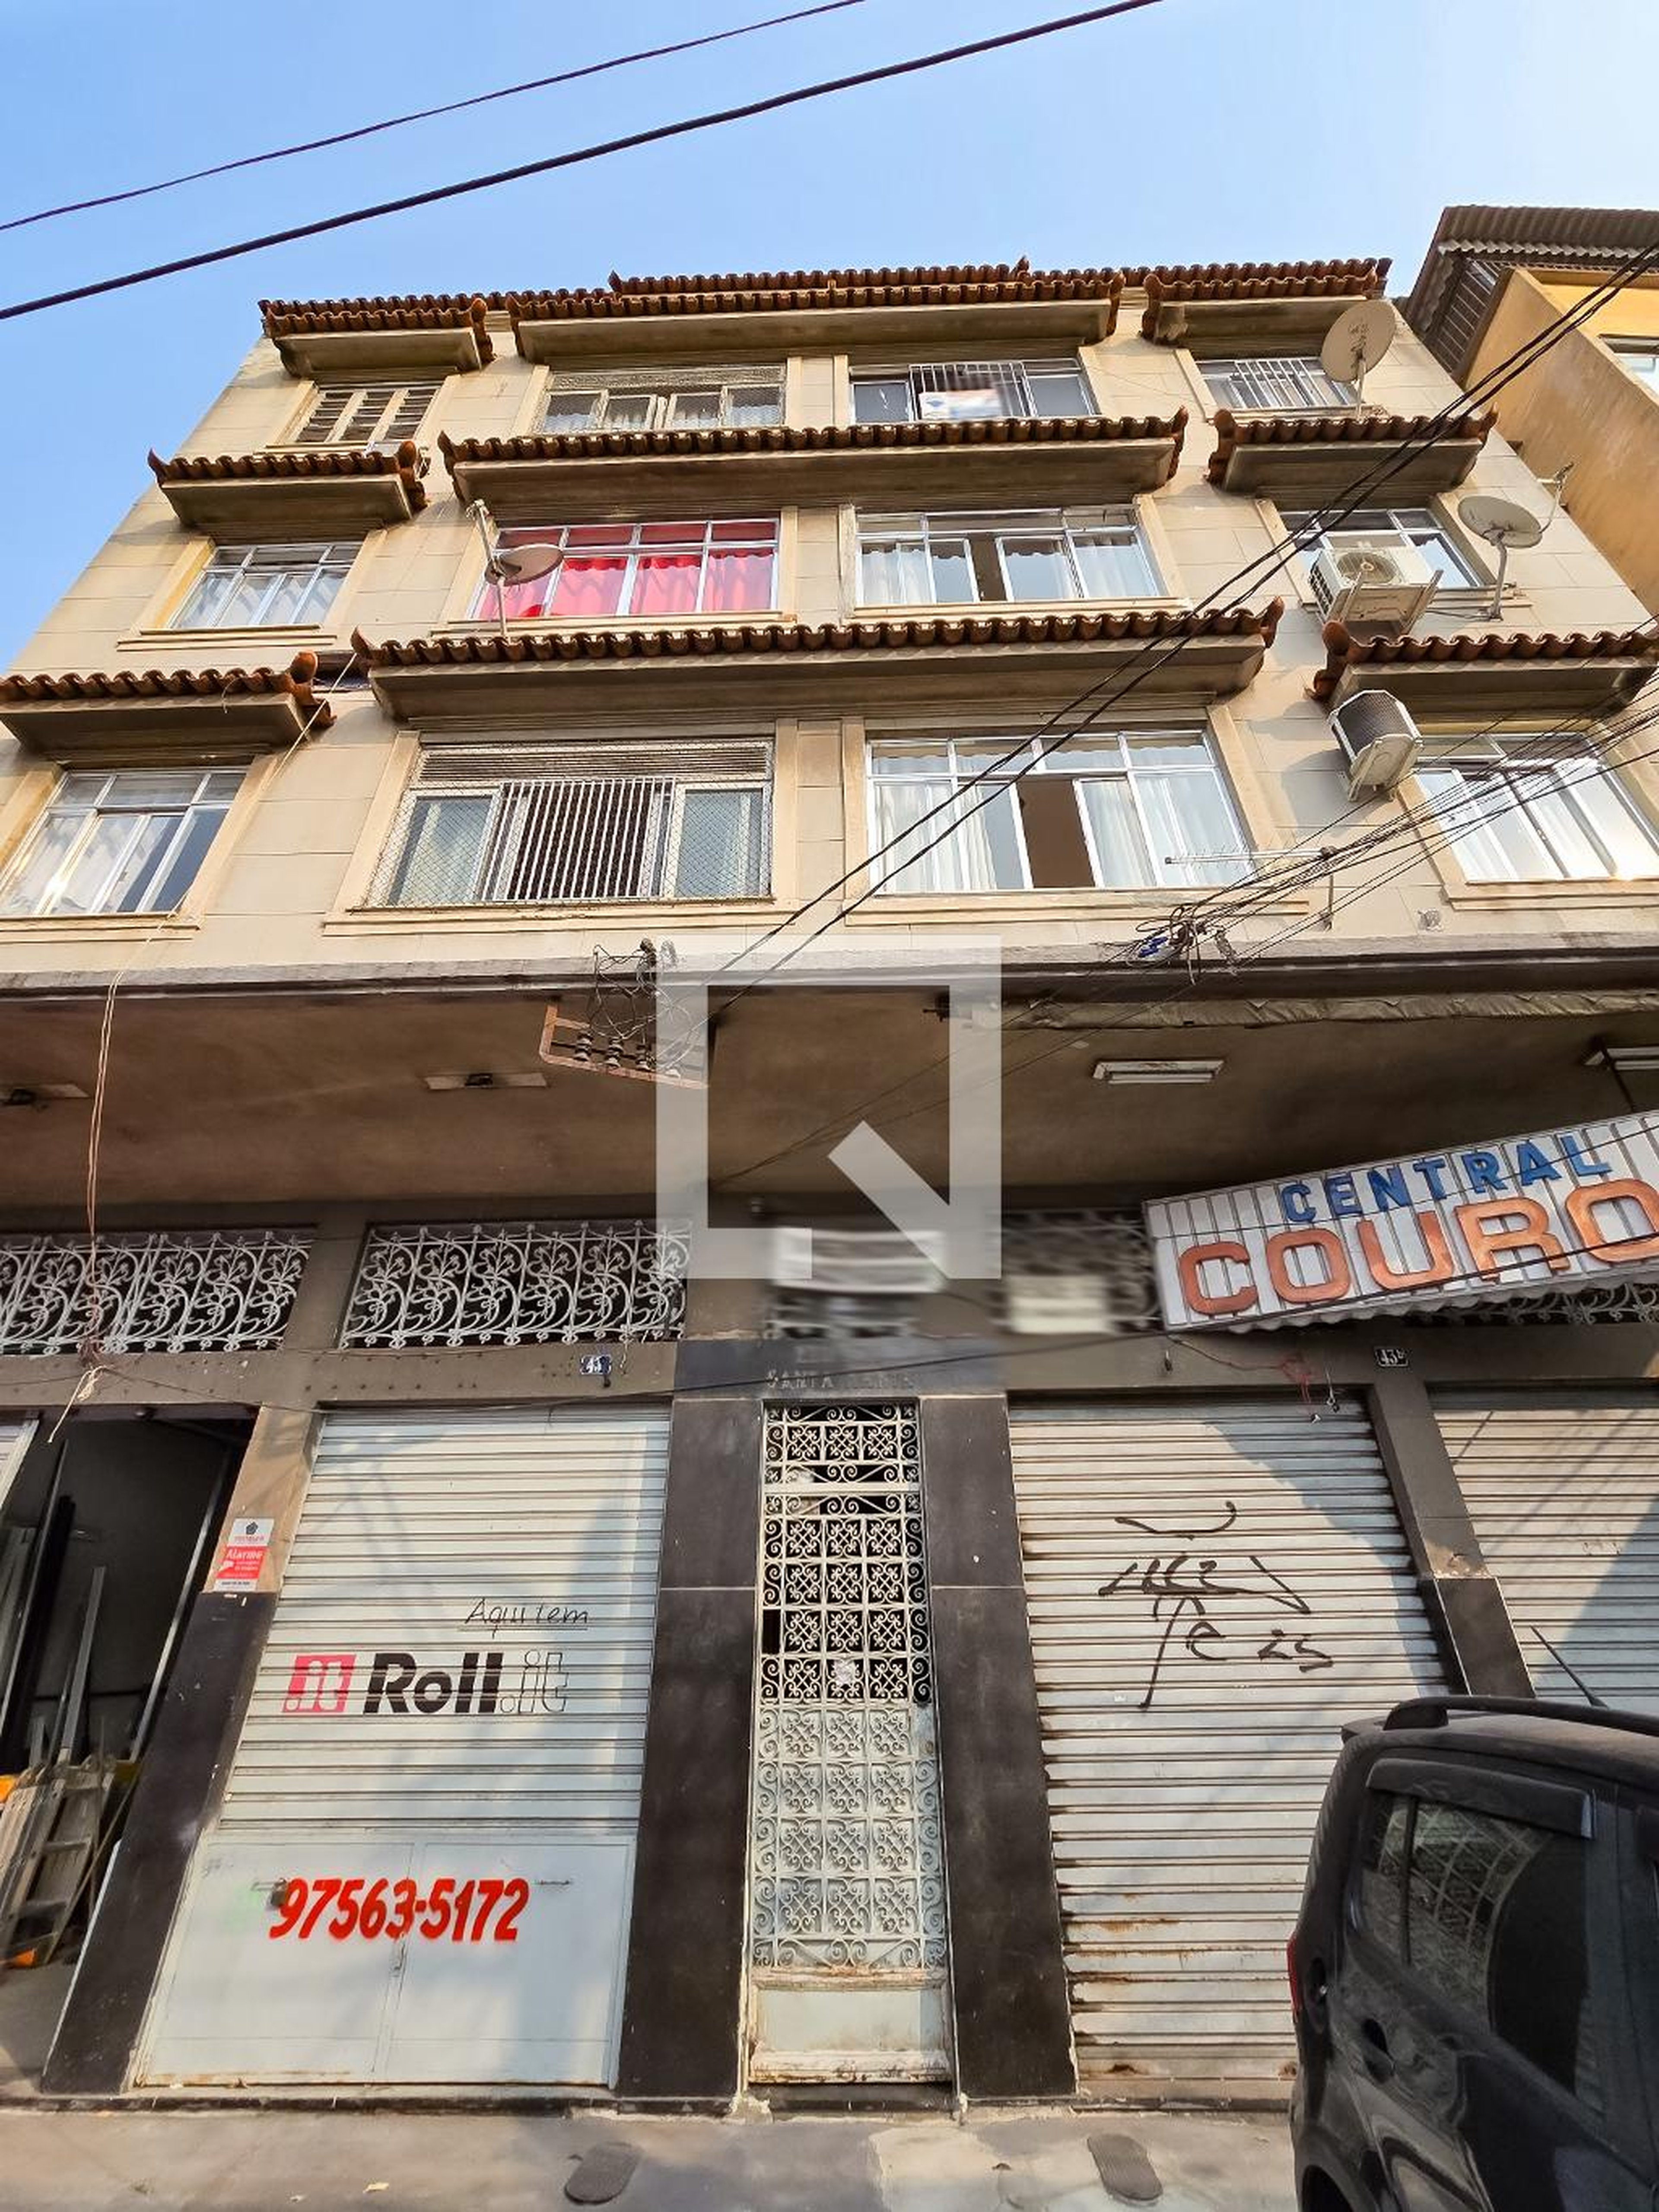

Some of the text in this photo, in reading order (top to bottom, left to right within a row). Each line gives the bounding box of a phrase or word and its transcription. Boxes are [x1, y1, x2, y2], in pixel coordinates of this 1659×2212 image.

[1280, 1134, 1613, 1223] CENTRAL
[1178, 1178, 1659, 1315] COURO
[269, 1878, 530, 1941] 97563-5172
